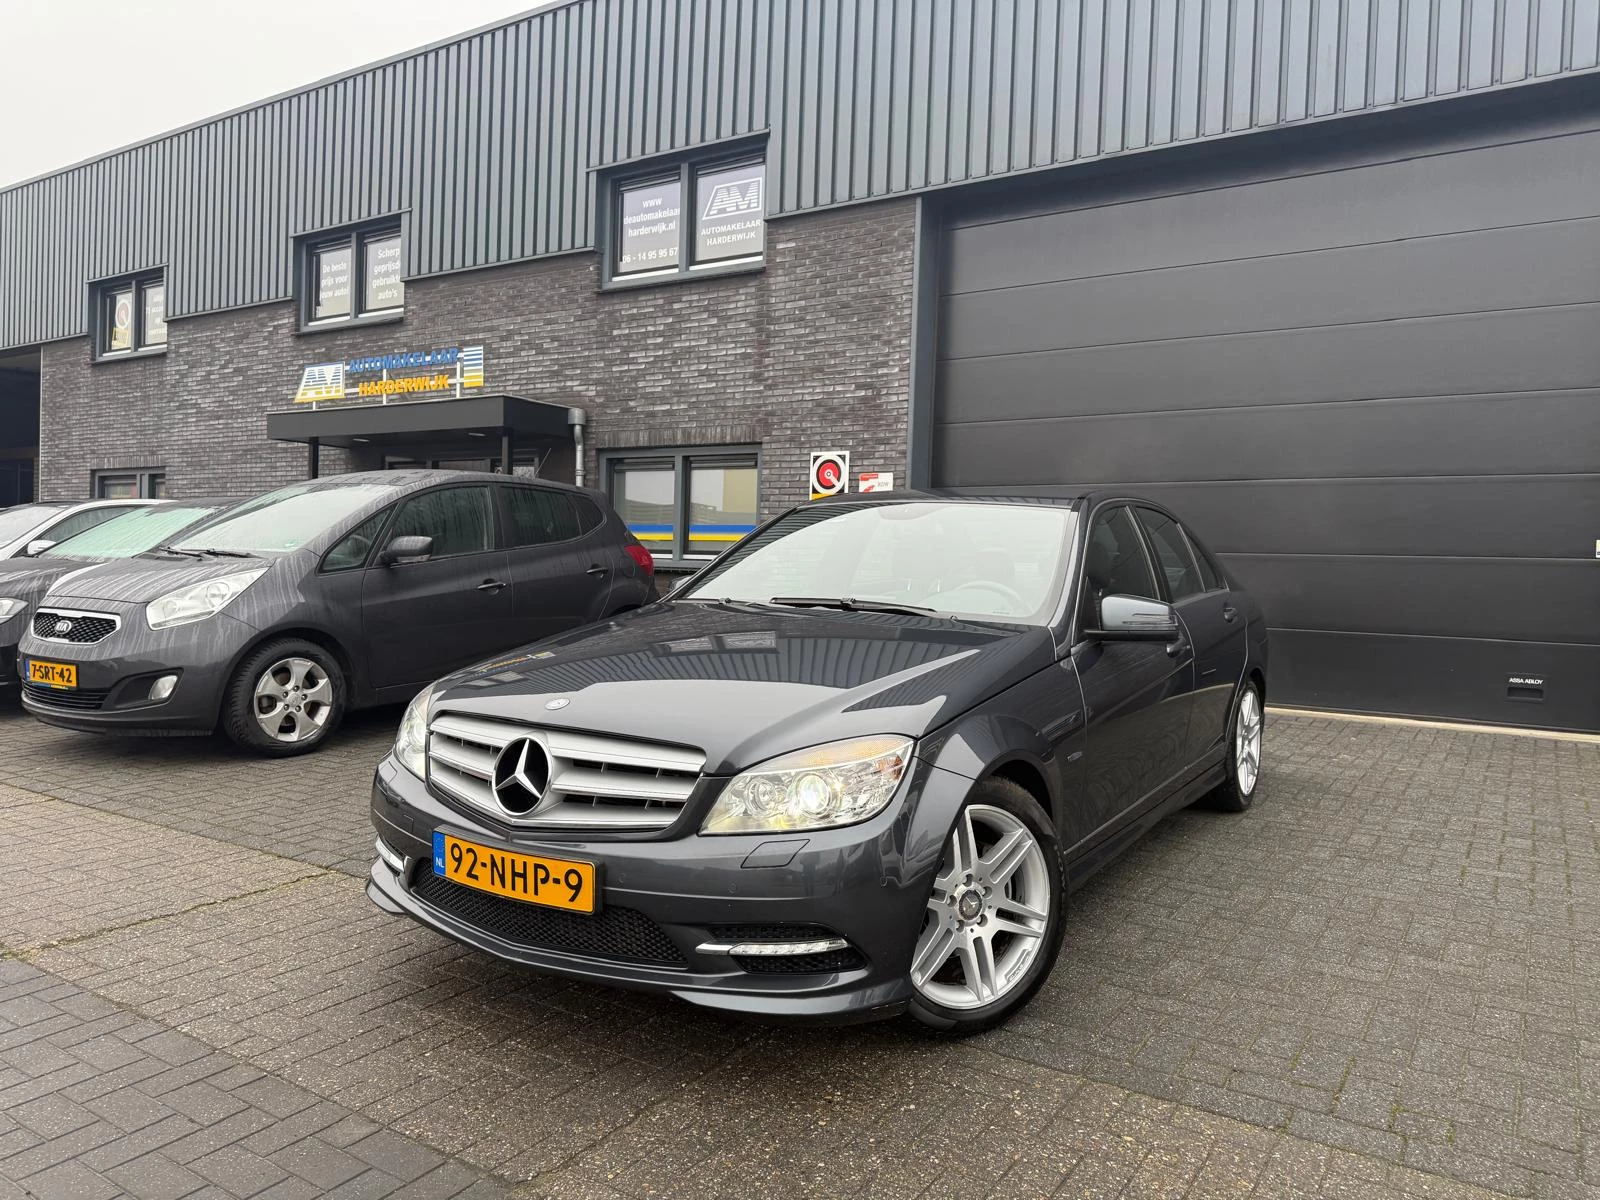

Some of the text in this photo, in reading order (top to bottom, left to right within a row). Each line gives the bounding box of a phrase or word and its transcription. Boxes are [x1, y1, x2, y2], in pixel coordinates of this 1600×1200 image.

[643, 198, 662, 208] www
[628, 221, 676, 237] harderwijk.nl
[701, 219, 761, 236] AUTOMAKELAAR
[706, 231, 756, 246] HARDERWIJK
[638, 251, 647, 262] 14
[373, 260, 400, 275] geprijsd
[349, 347, 460, 374] AUTOMAKELAAR
[359, 375, 449, 397] HARDERWIJK
[31, 664, 73, 683] 7-SRT-42
[435, 857, 445, 869] NL
[450, 843, 583, 902] 92-NHP-9
